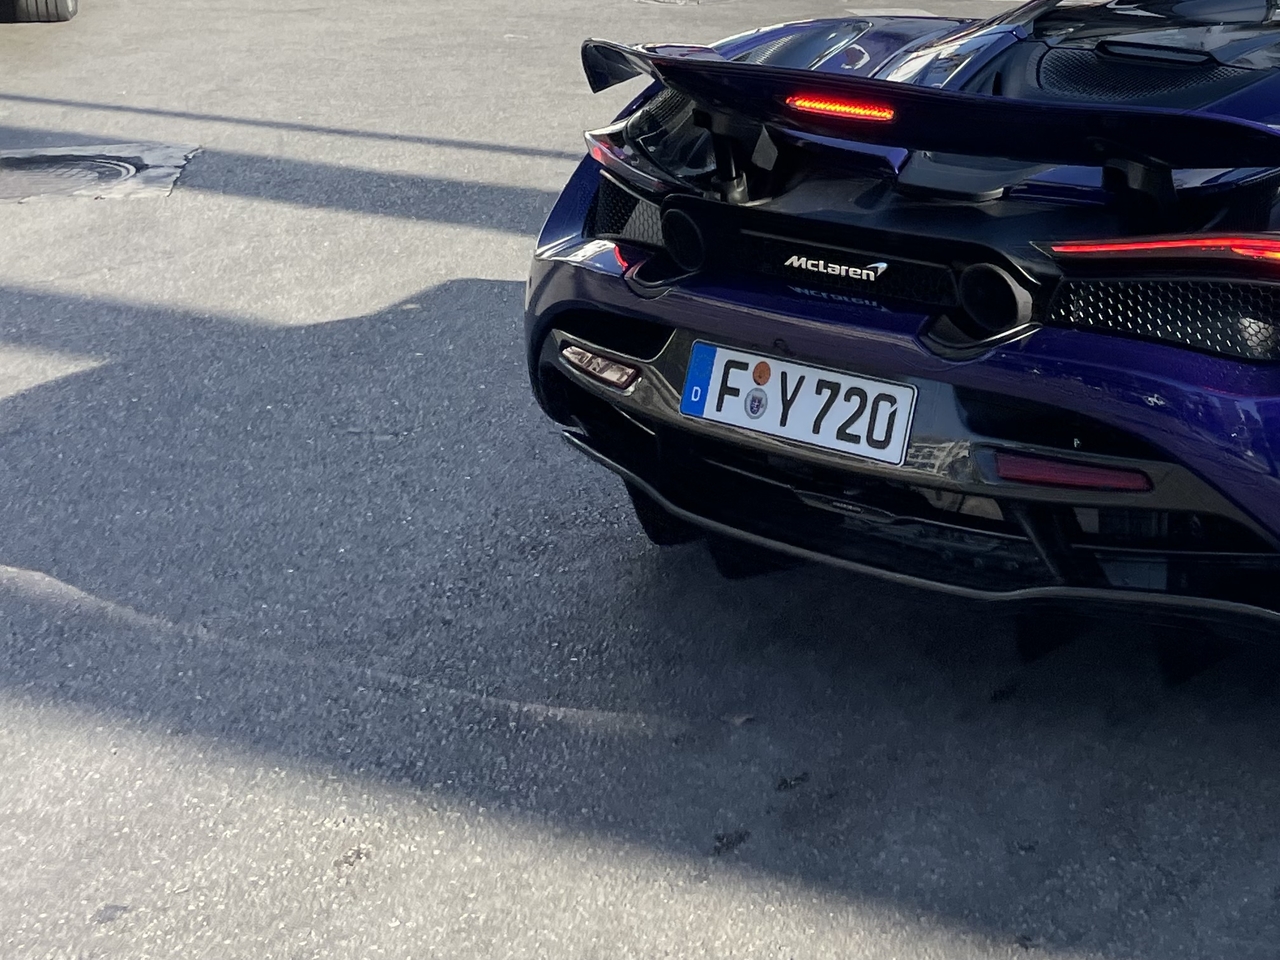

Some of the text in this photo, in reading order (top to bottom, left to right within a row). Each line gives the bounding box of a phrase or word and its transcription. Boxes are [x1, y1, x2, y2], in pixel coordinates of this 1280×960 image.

[784, 255, 876, 282] McLaren
[691, 386, 702, 402] D
[715, 359, 898, 451] F Y 720
